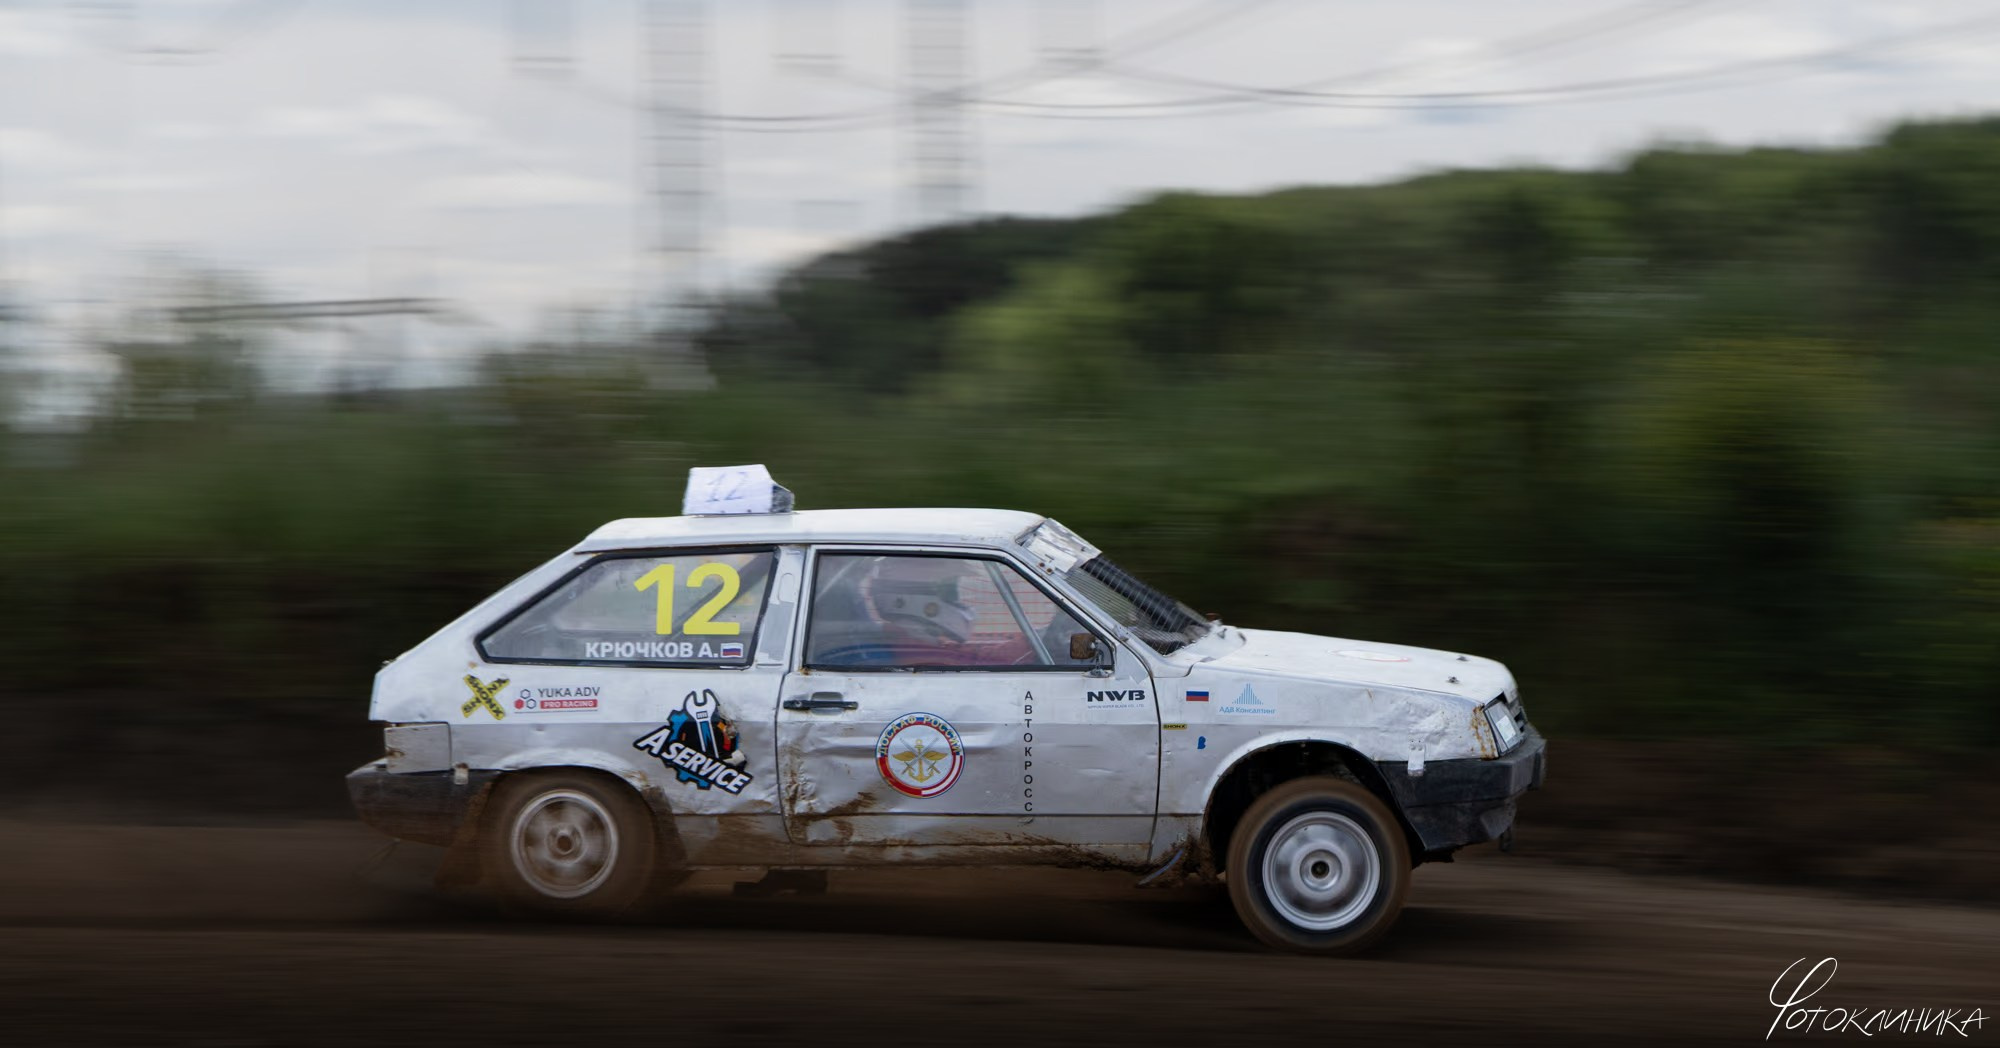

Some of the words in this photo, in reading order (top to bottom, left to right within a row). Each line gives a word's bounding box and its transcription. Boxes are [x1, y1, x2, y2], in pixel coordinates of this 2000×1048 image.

[705, 471, 748, 503] 12
[633, 562, 740, 635] 12
[585, 641, 694, 659] КРЮЧКОВ
[698, 642, 718, 659] А.
[537, 687, 572, 698] YUKA
[574, 686, 601, 697] ADV
[1087, 690, 1145, 702] NWB
[878, 715, 917, 756] ДОСААФ
[923, 715, 962, 753] РОССИИ
[1023, 690, 1034, 812] АВТОКРОСС
[637, 728, 672, 755] A
[661, 742, 750, 793] SERVICE
